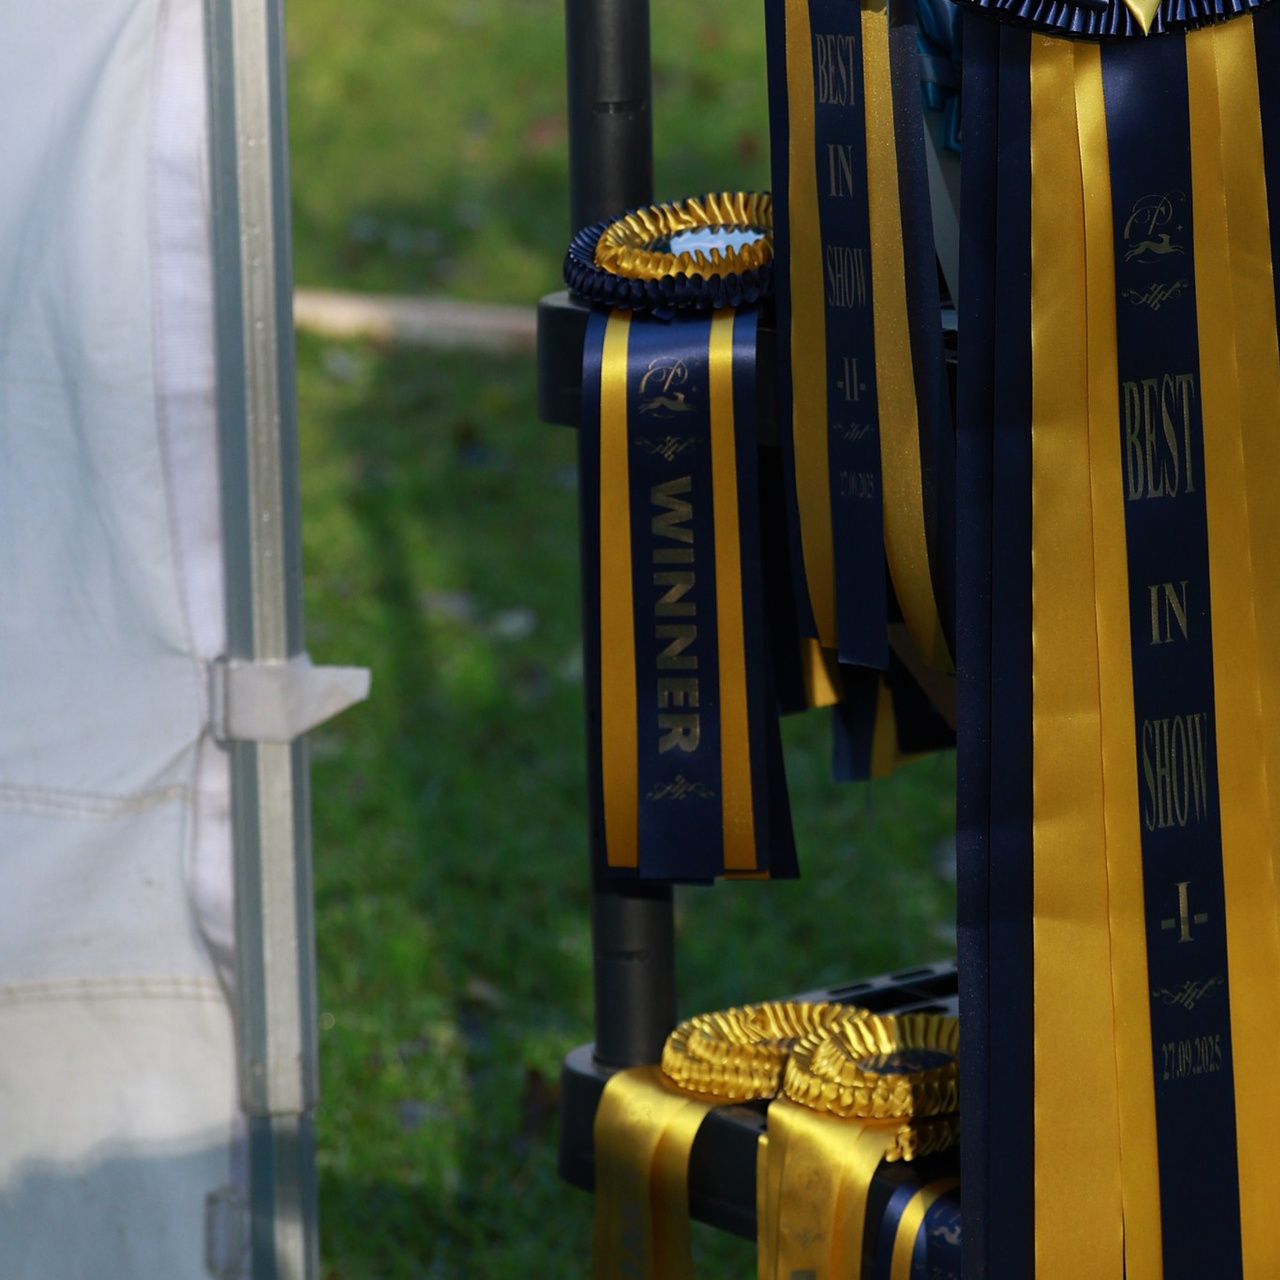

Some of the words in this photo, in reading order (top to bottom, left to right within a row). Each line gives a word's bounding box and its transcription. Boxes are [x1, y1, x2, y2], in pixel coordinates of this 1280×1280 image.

[815, 33, 857, 107] BEST
[828, 143, 853, 198] IN
[826, 244, 868, 309] SHOW
[1122, 373, 1196, 502] BEST
[650, 475, 701, 756] WINNER
[1147, 580, 1190, 646] IN
[1142, 712, 1208, 833] SHOW
[1161, 1034, 1222, 1080] 27.09.2025
